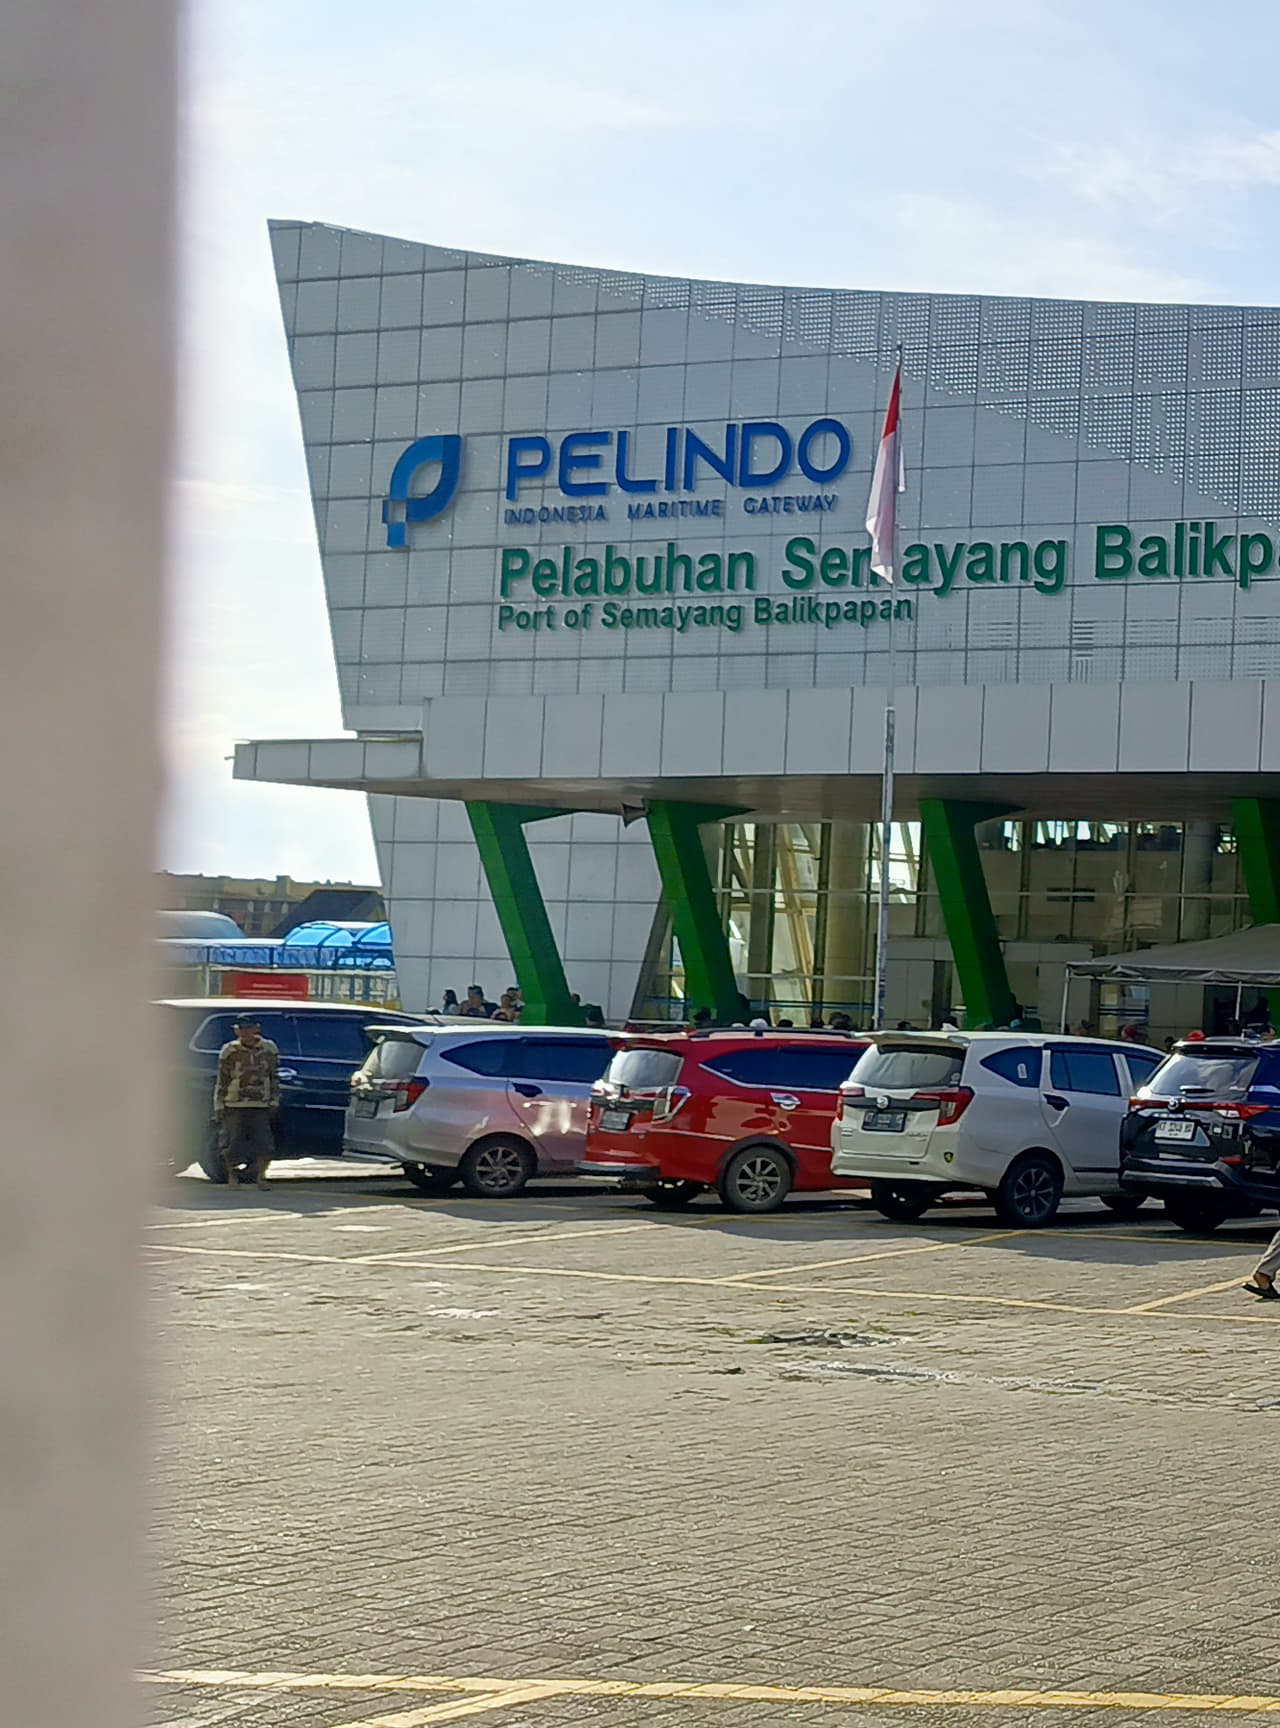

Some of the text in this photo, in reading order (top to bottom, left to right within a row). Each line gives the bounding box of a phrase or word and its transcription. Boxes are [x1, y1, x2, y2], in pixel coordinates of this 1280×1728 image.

[506, 418, 851, 501] PELINDO
[504, 494, 838, 525] INDONESIA MARITIME GATEWAY
[501, 543, 755, 598] Pelabuhan
[498, 596, 914, 632] Port of Semayang Balikpapan
